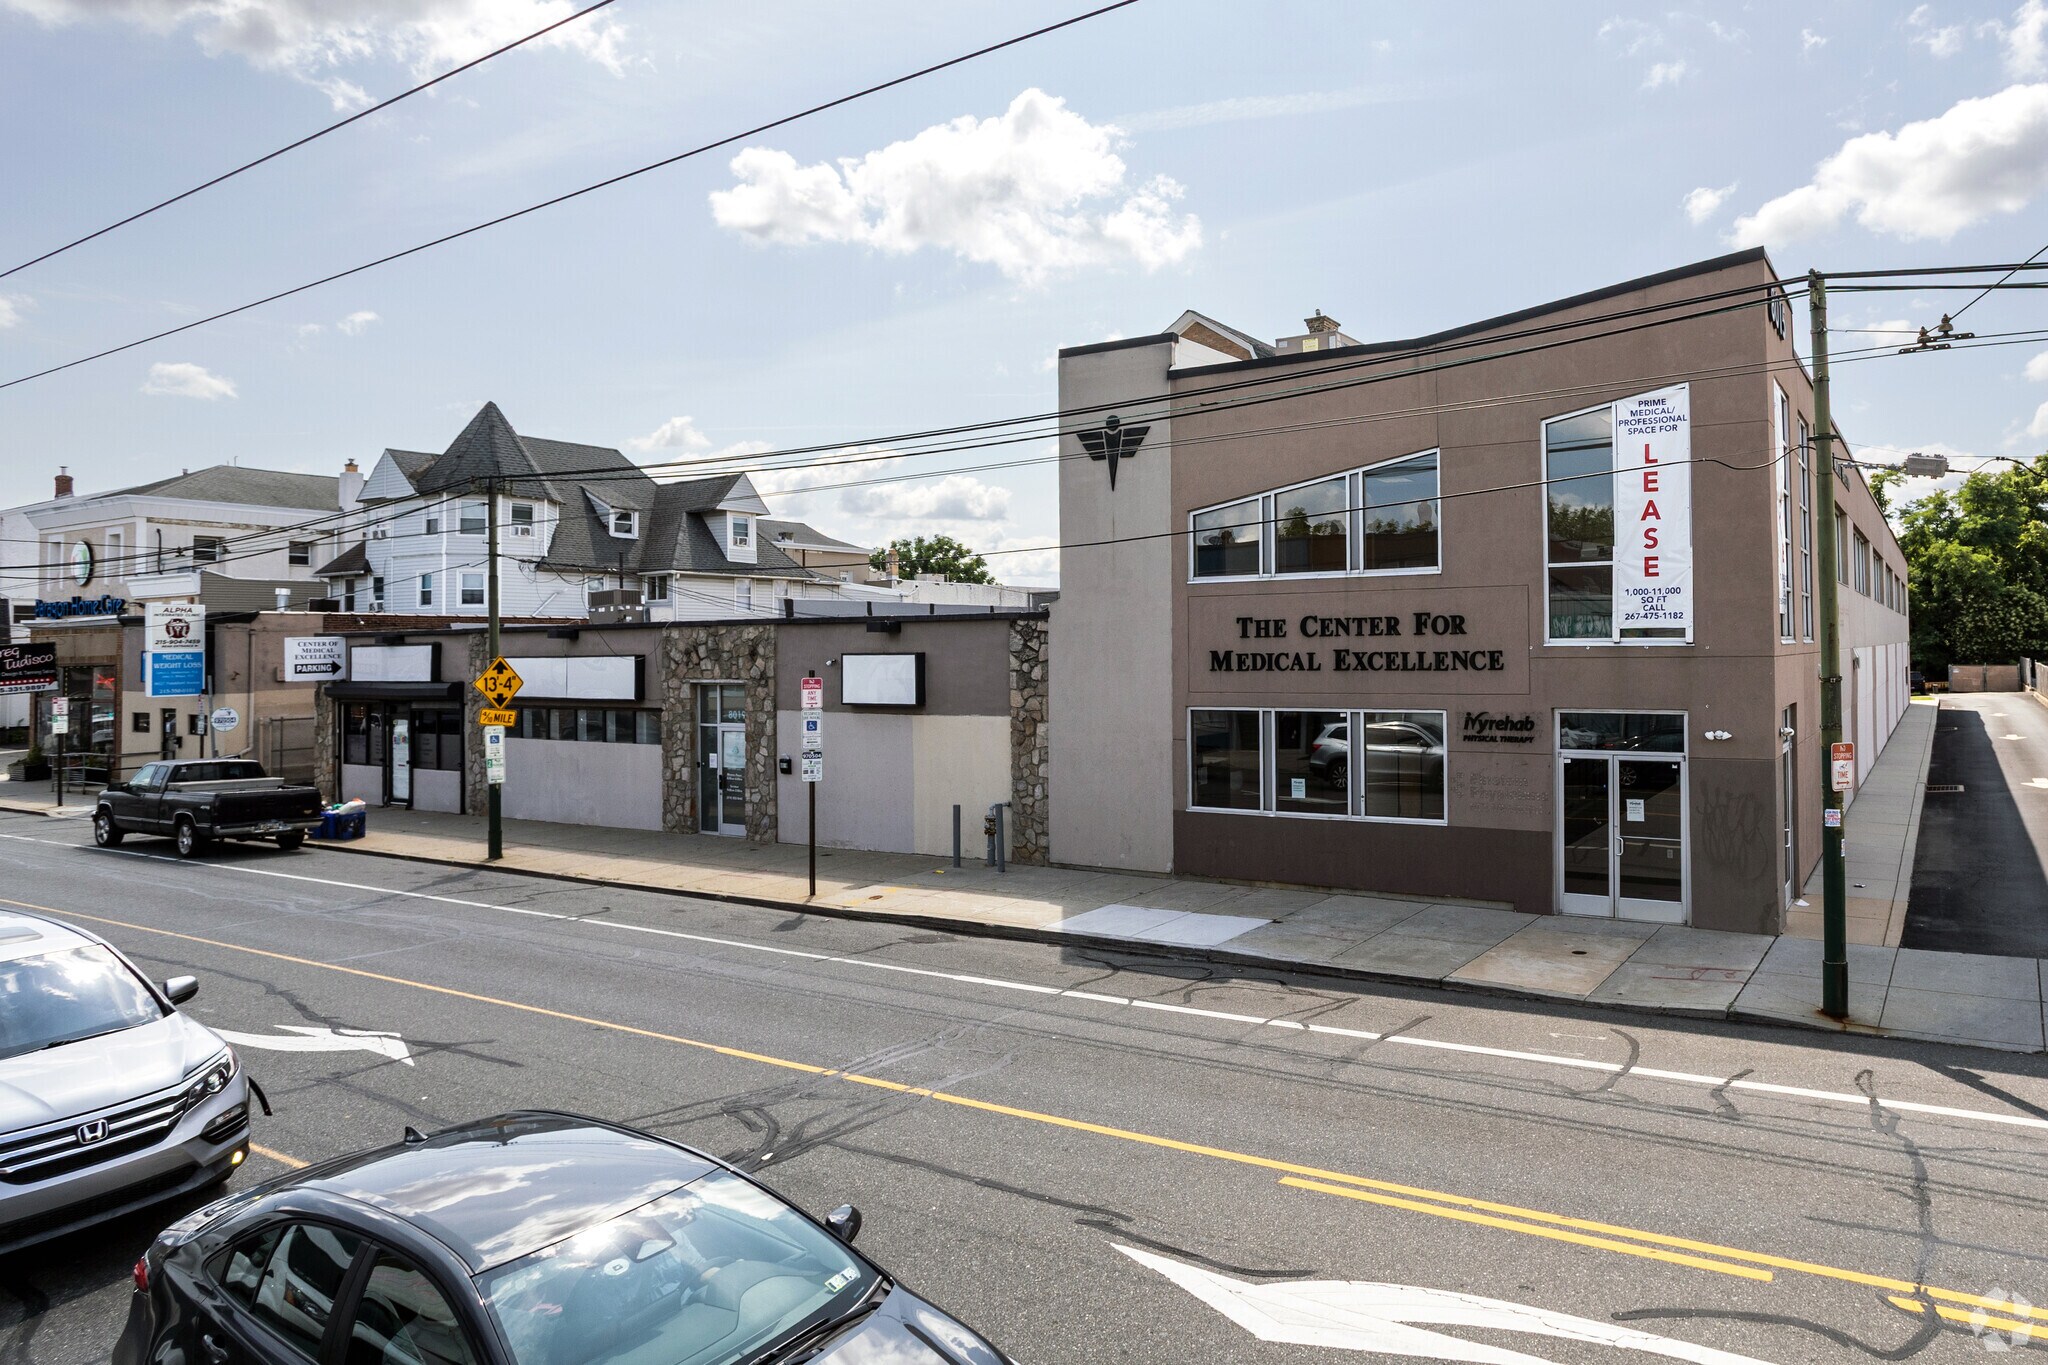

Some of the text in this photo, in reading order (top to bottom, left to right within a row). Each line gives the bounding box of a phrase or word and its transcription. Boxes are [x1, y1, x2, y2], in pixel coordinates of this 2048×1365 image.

[1638, 398, 1667, 407] PRIME
[1630, 406, 1675, 417] MEDICAL/
[1618, 414, 1688, 427] PROFESSIONAL
[1628, 424, 1678, 435] SPACE FOR
[1640, 443, 1661, 577] LEASE
[1625, 587, 1681, 597] 1,000-11,000
[71, 596, 99, 615] Home
[101, 595, 125, 614] Care
[1641, 596, 1654, 604] SQ
[1625, 612, 1684, 620] 267-475-1182
[1236, 613, 1467, 638] THE CENTER FOR
[0, 647, 19, 658] reg
[3, 654, 53, 670] Tudisco
[1209, 649, 1504, 672] MEDICAL EXCELLENCE
[296, 664, 332, 673] PARKING
[494, 714, 513, 723] MILE
[1833, 752, 1852, 760] STOPPING
